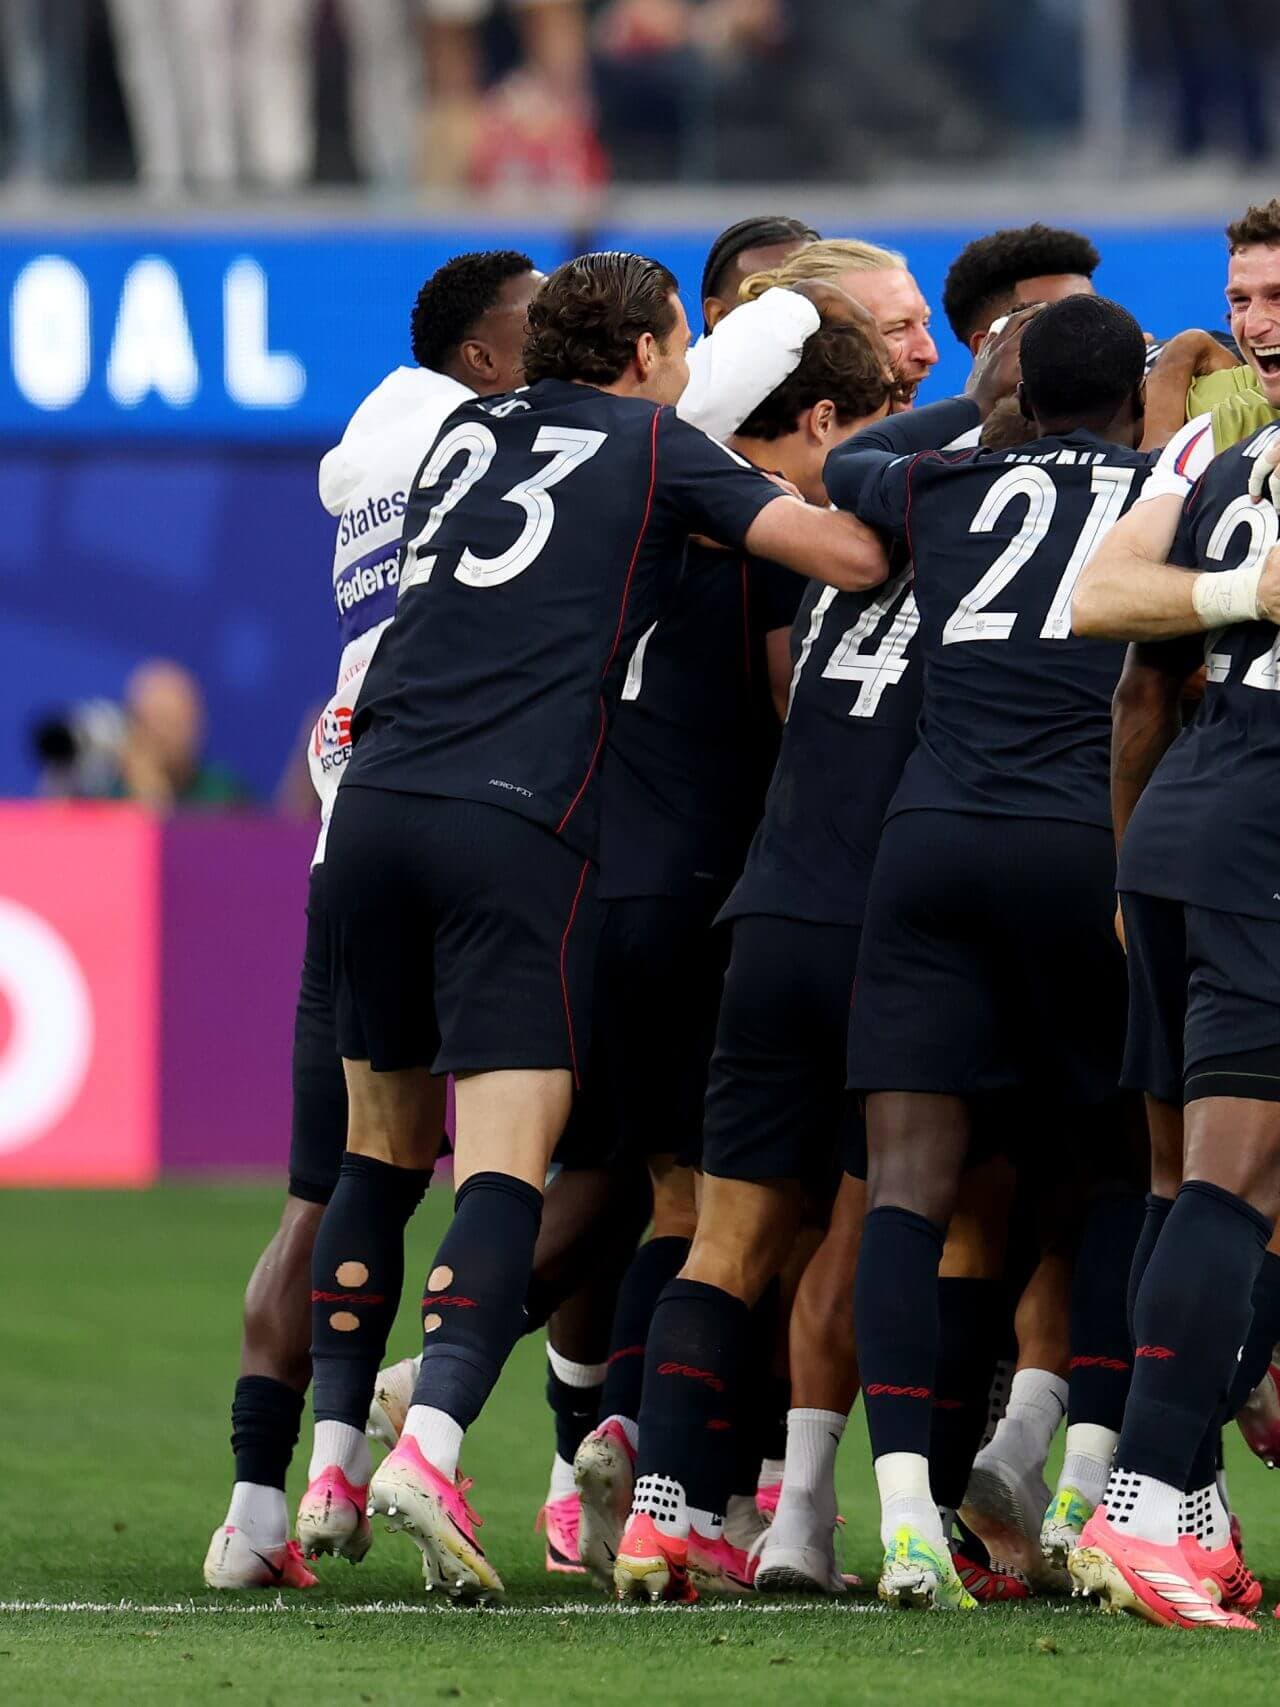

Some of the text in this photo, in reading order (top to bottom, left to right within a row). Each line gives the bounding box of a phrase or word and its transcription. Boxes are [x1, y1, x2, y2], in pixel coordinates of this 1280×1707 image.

[341, 490, 408, 546] States
[398, 422, 608, 598] 23
[942, 465, 1136, 645] 21
[336, 549, 401, 616] Federa
